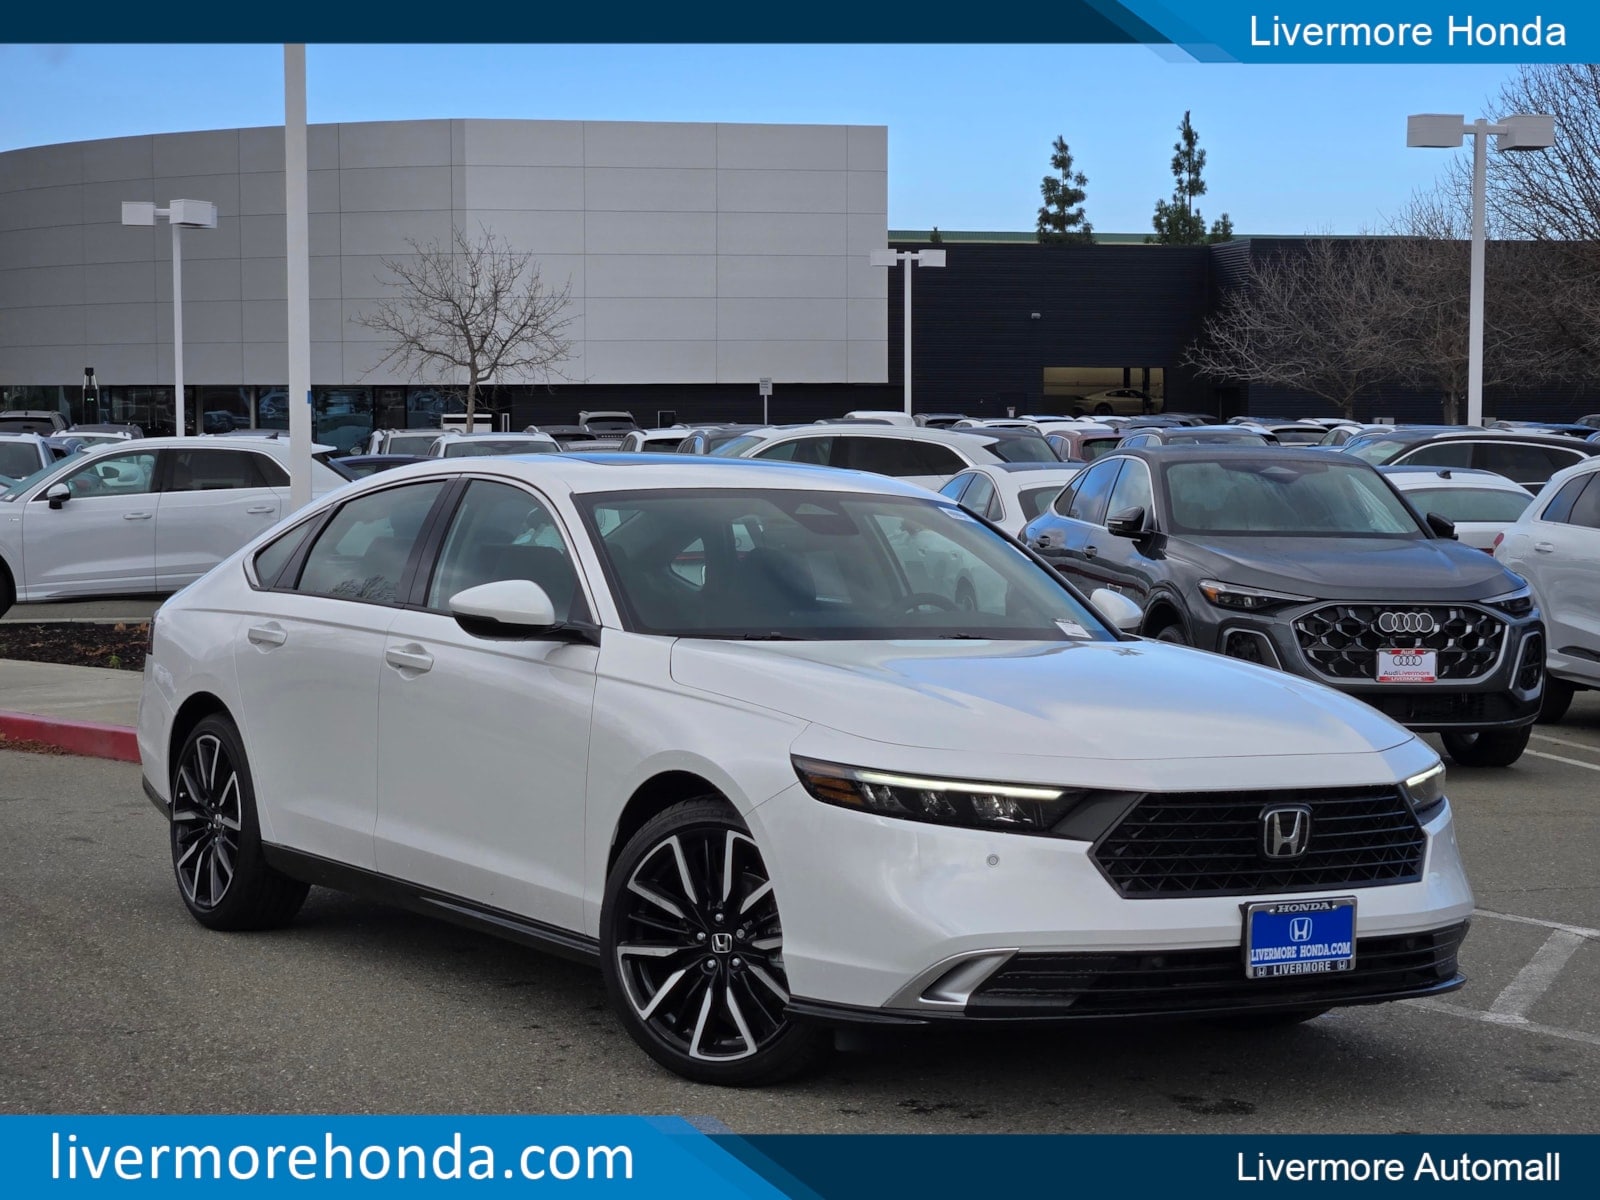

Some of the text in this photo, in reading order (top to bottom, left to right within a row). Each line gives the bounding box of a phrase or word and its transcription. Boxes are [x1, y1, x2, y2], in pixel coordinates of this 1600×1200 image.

[1277, 902, 1331, 913] HONDA
[1251, 942, 1351, 961] LIVERMORE HONDA.COM
[1273, 961, 1331, 976] LIVERMORE
